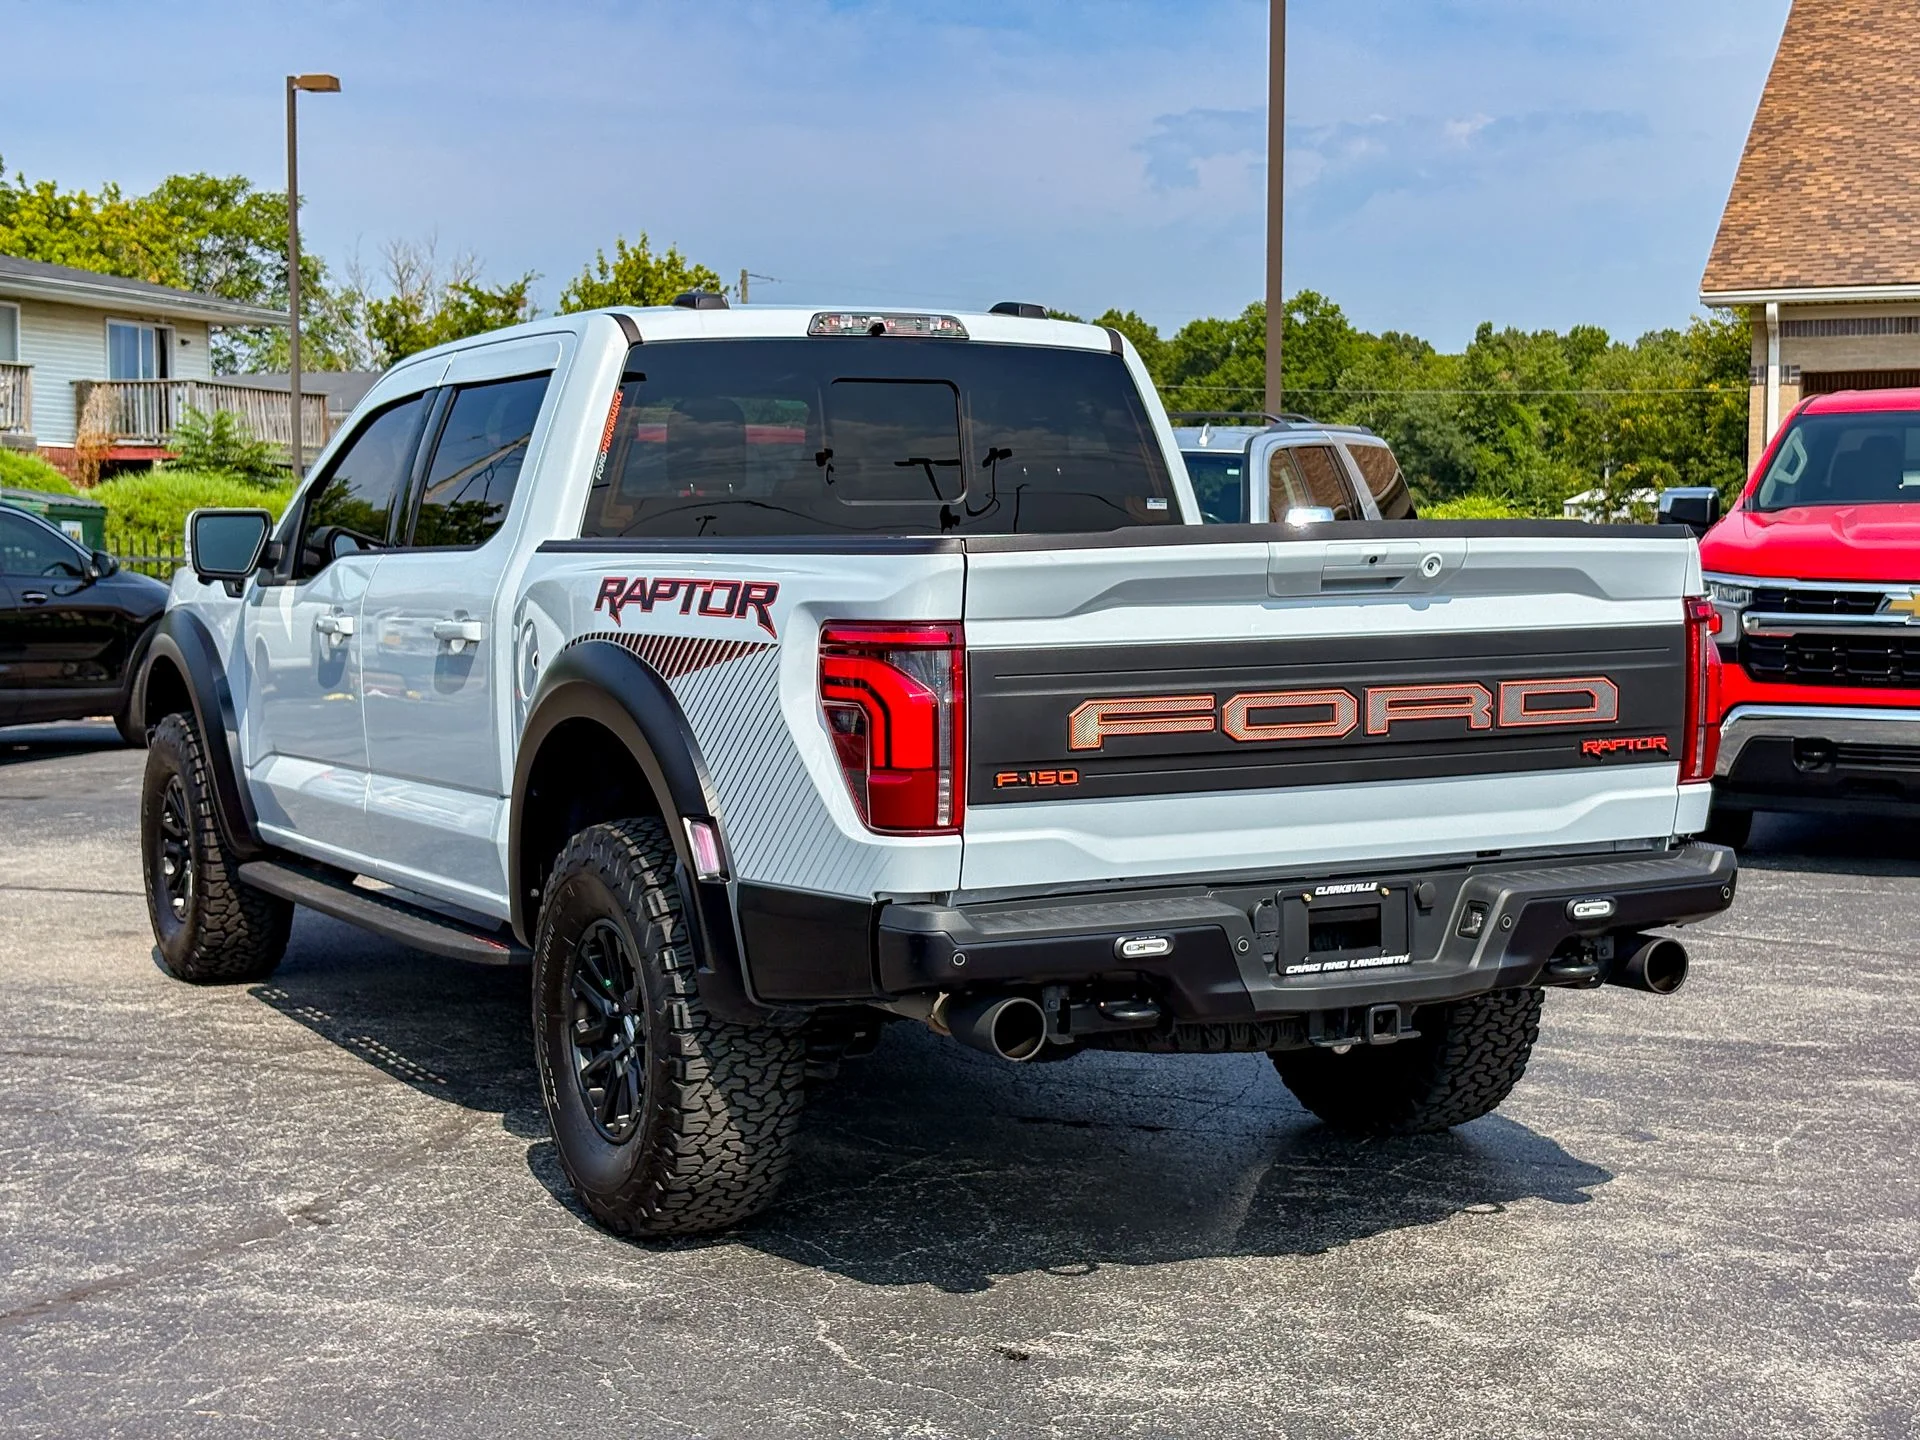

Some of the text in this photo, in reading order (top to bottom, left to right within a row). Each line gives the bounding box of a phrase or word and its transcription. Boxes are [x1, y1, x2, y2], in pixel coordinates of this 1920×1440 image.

[594, 576, 780, 640] RAPTOR
[1068, 676, 1619, 751] FORD
[1582, 735, 1669, 757] RAPTOR
[995, 769, 1079, 788] F-150
[1314, 882, 1378, 896] CLARKSVILLE
[1322, 960, 1349, 971] AND
[1349, 953, 1411, 969] LANDRETH
